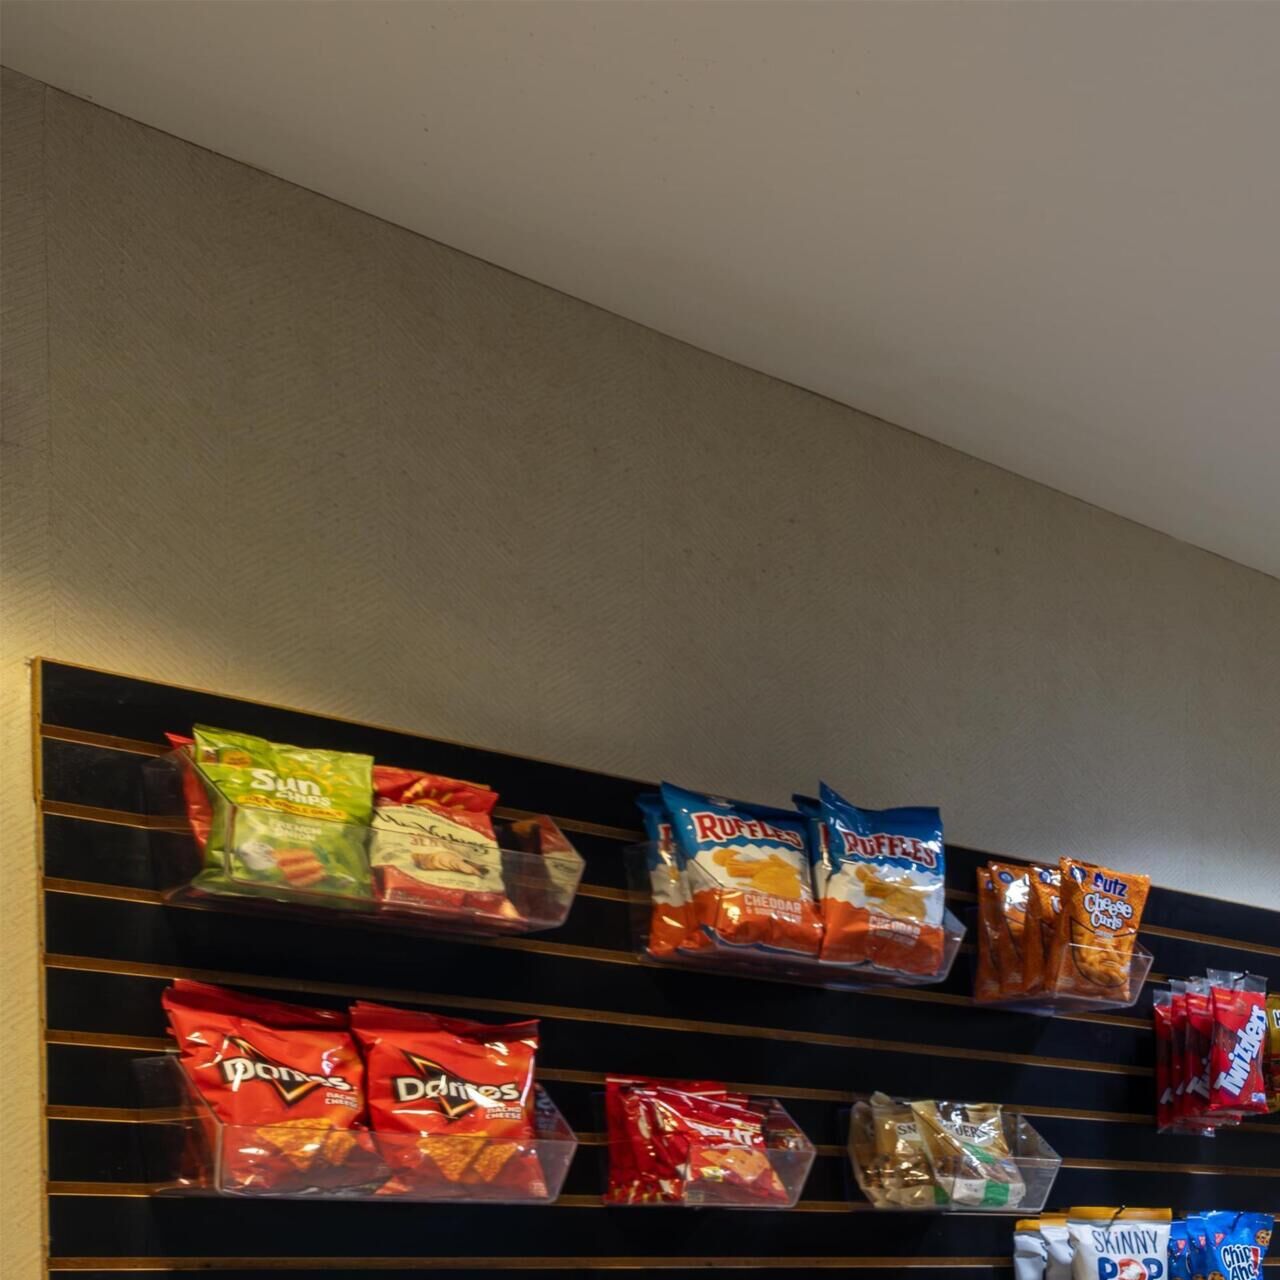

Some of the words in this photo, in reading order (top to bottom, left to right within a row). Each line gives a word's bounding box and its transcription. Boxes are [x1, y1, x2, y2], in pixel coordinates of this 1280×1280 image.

[251, 768, 322, 796] Sun
[274, 790, 332, 809] CHIPS
[690, 811, 804, 850] RUFFLES
[841, 830, 937, 869] RUFFLES
[743, 893, 802, 913] CHEDDAR
[1083, 892, 1133, 919] Cheese
[1090, 909, 1124, 931] Curls
[395, 1076, 520, 1104] Doritos
[485, 1112, 522, 1121] CHEESE
